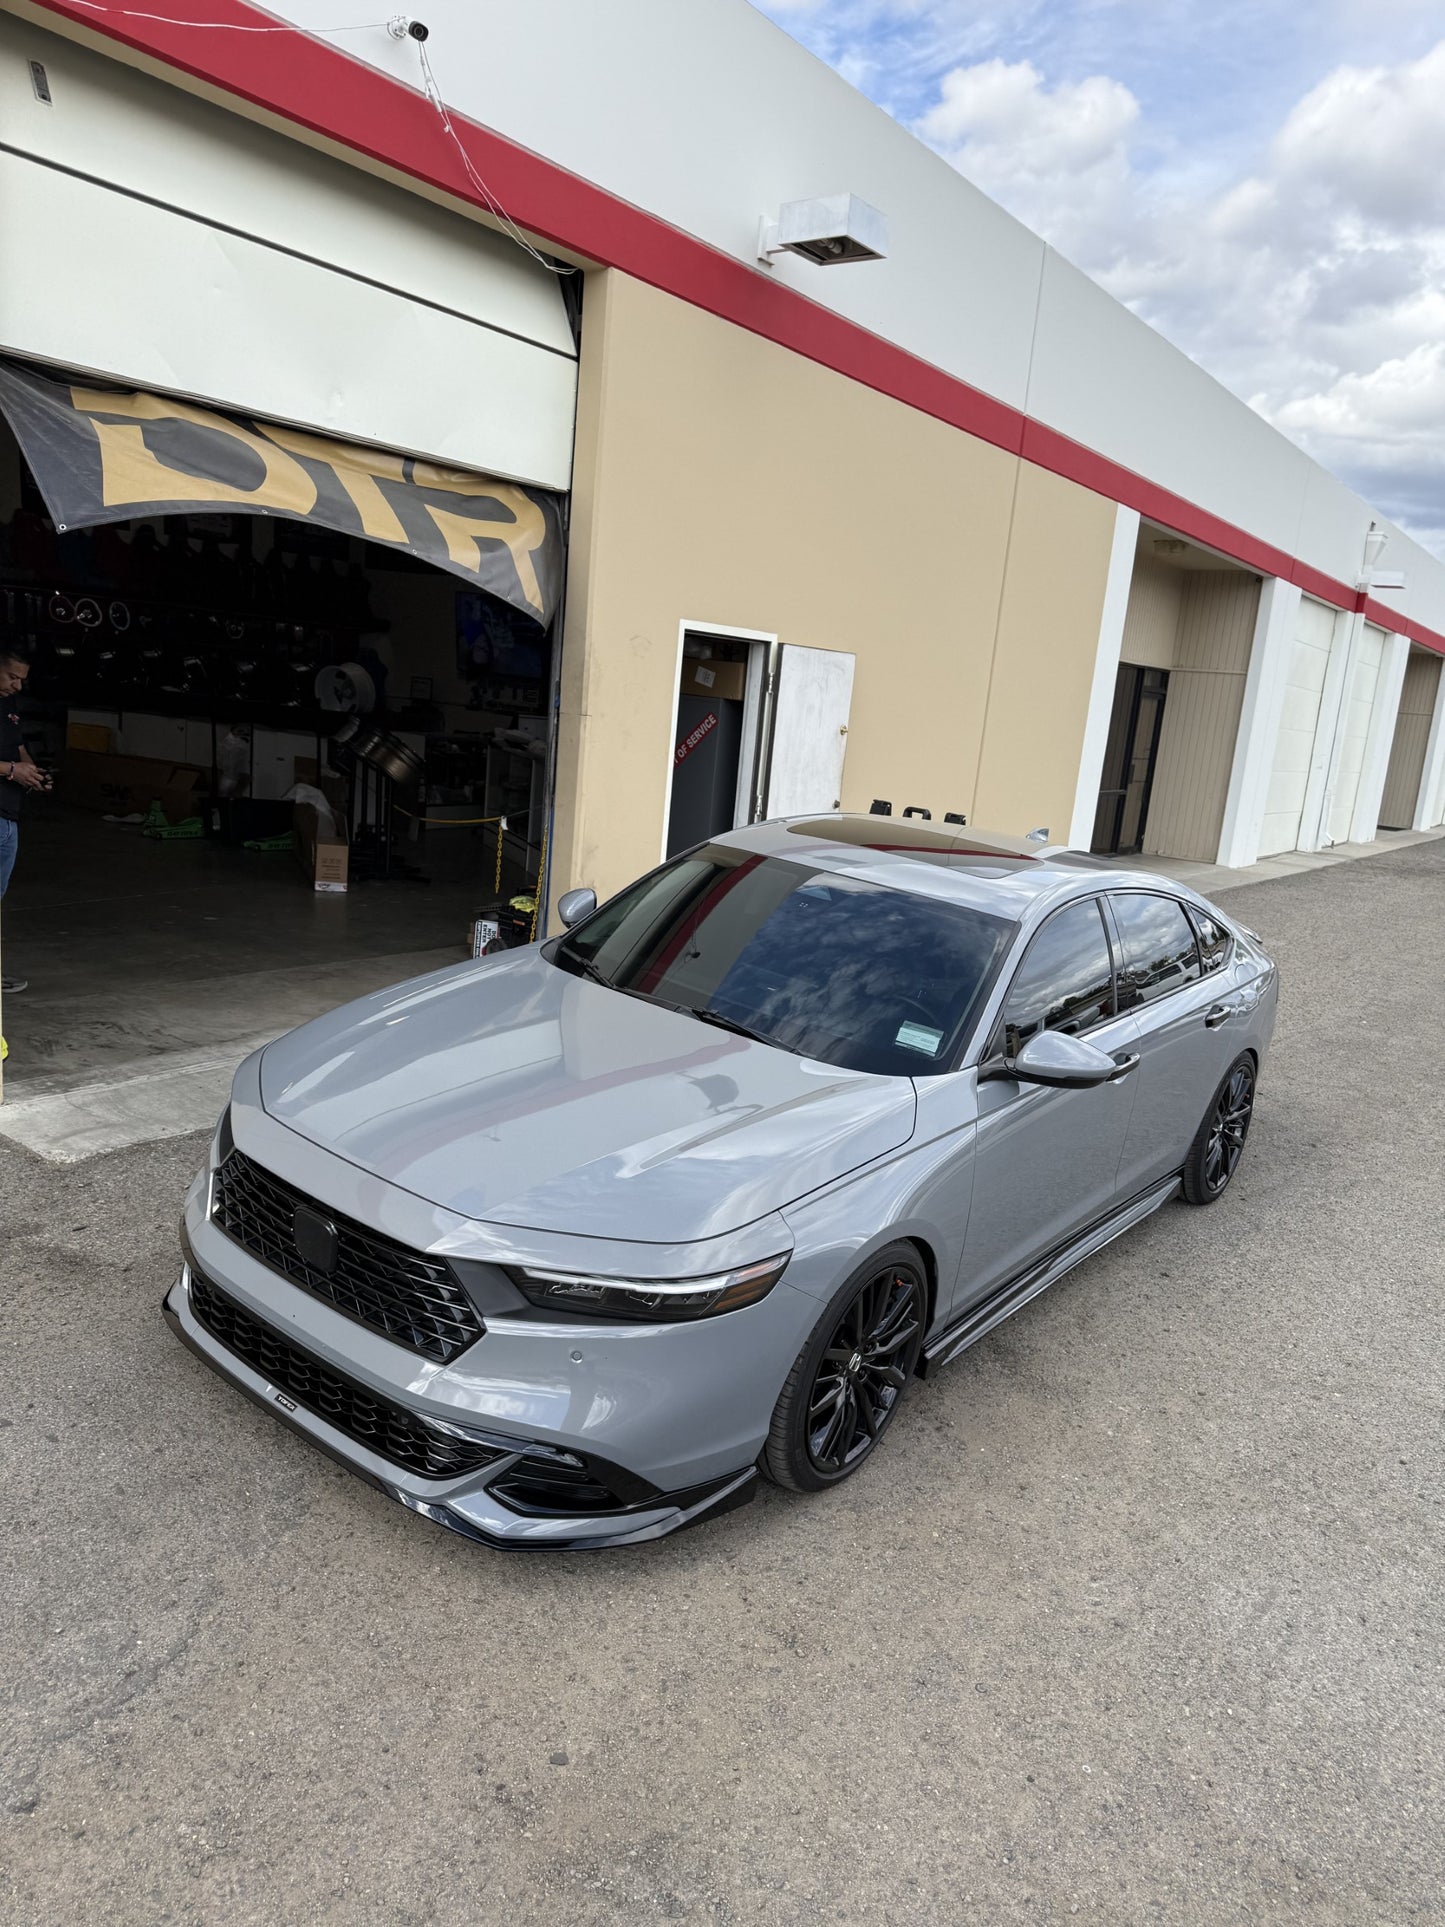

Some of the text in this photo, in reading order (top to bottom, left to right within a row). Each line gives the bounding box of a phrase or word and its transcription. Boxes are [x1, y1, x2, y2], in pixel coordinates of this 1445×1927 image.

[70, 386, 547, 614] DTR
[677, 714, 717, 758] OF SERVICE
[491, 930, 497, 939] DO
